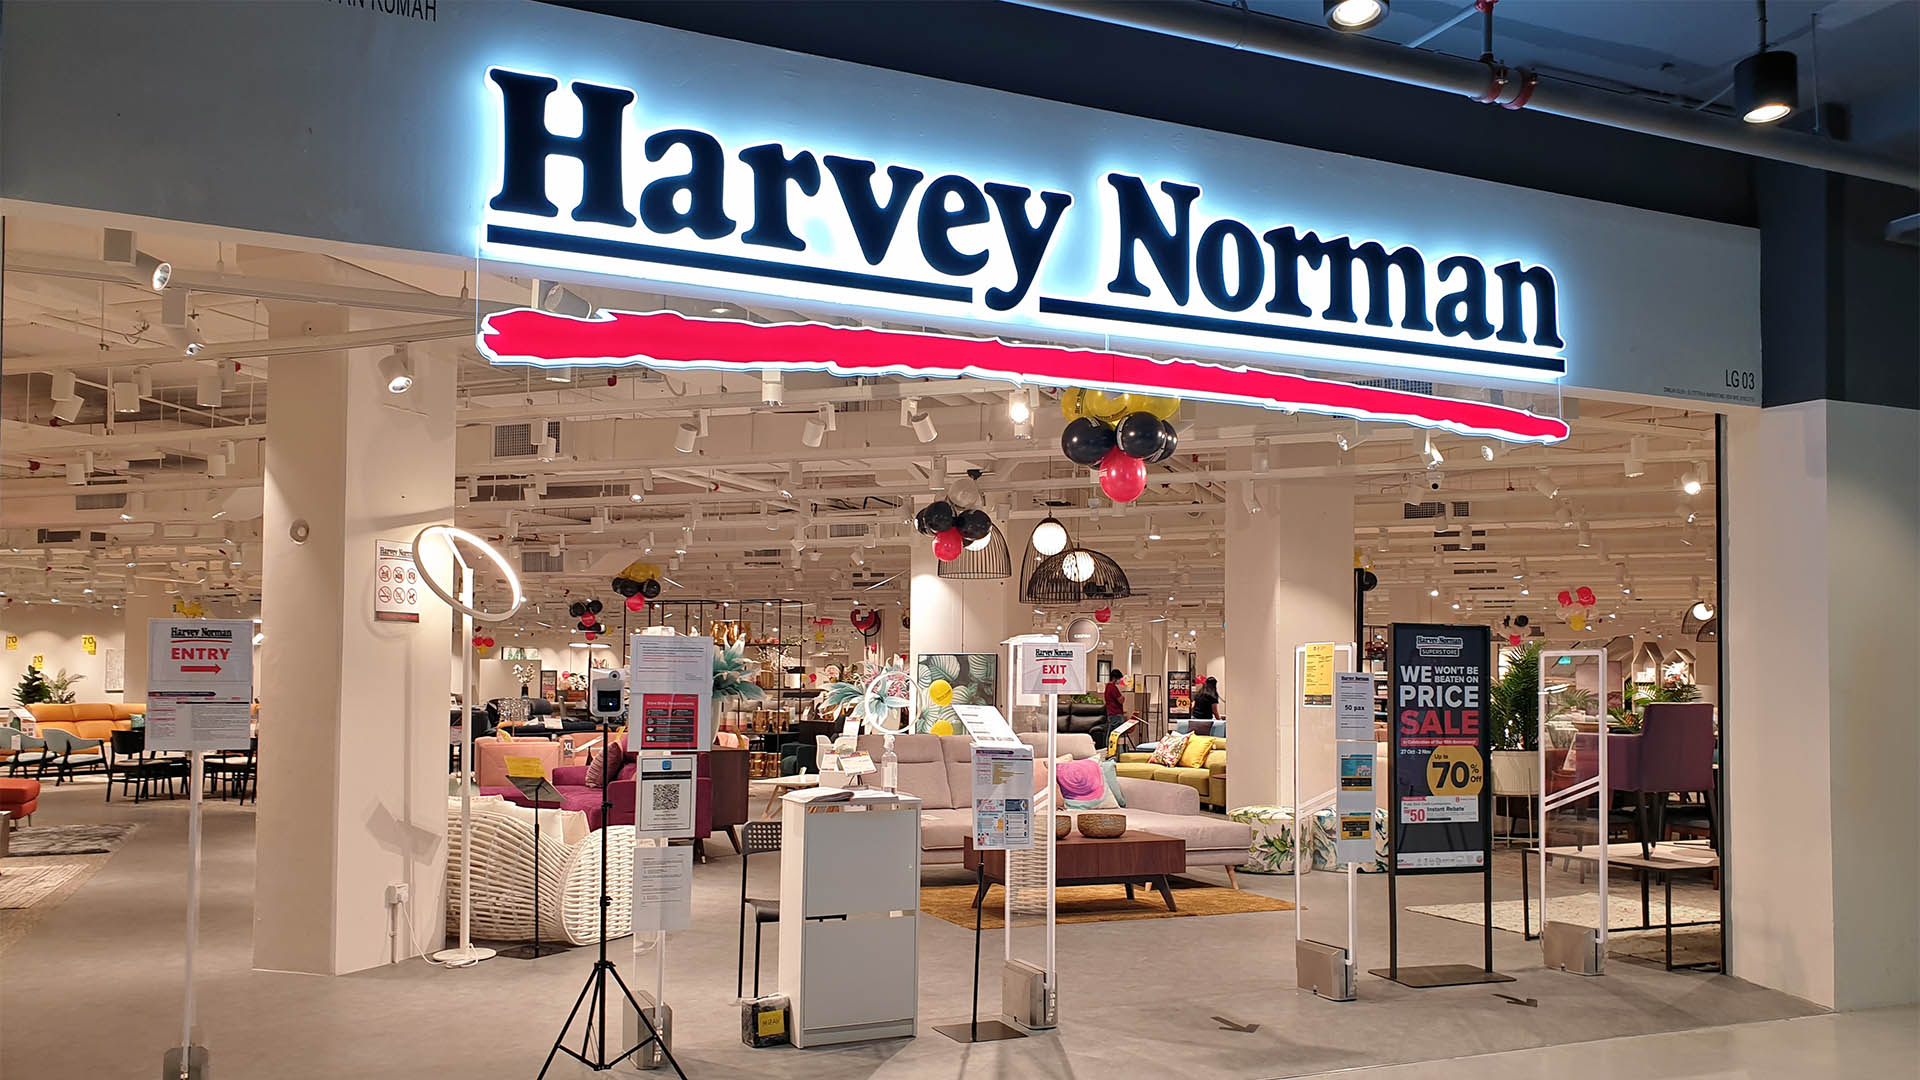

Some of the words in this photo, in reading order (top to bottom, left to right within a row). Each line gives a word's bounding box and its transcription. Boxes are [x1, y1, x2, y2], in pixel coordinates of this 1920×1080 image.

[489, 69, 1072, 311] Harvey
[1107, 173, 1565, 348] Norman
[1726, 369, 1739, 388] LG
[1742, 372, 1755, 390] 03
[171, 627, 199, 637] Harvey
[201, 628, 232, 637] Norman
[171, 648, 230, 660] ENTRY
[1035, 648, 1053, 657] Harvey
[1054, 649, 1073, 657] Norman
[1042, 665, 1067, 674] EXIT
[1400, 666, 1432, 682] WE
[1434, 666, 1464, 675] WON'T
[1400, 685, 1479, 707] PRICE
[1400, 709, 1479, 735] SALE
[1432, 761, 1470, 789] 70
